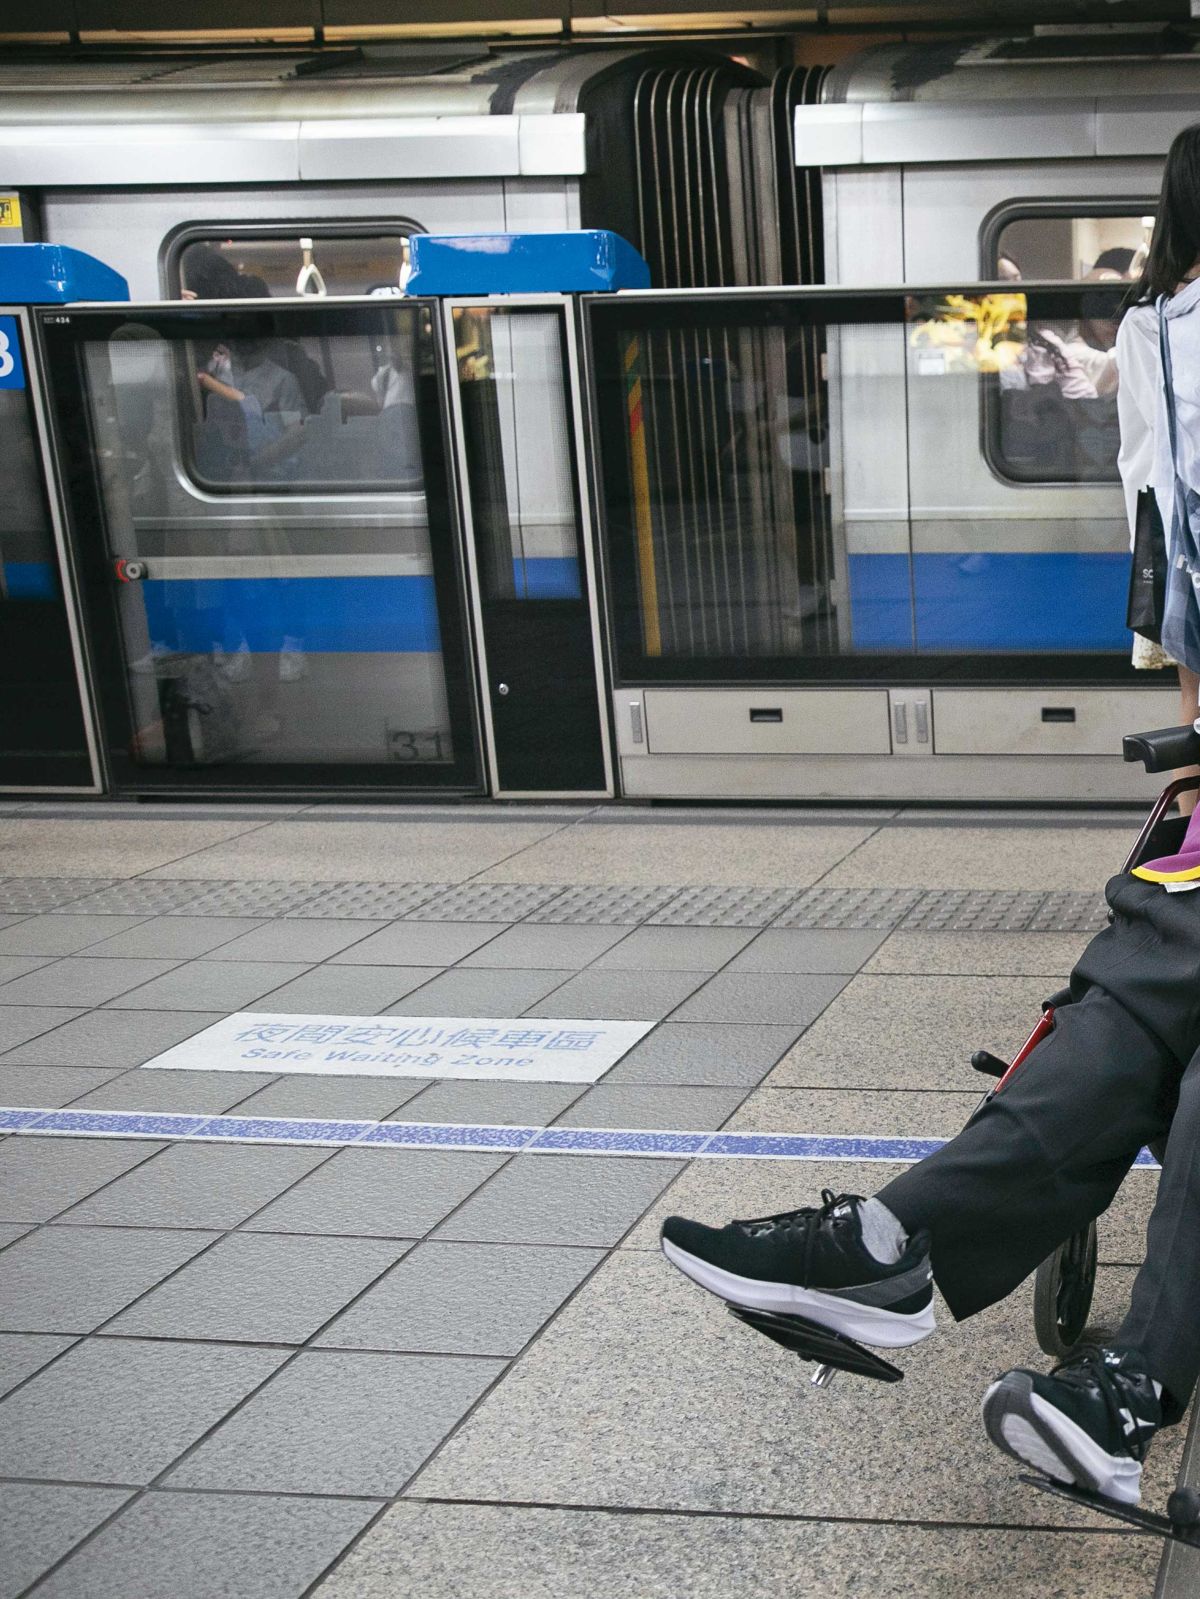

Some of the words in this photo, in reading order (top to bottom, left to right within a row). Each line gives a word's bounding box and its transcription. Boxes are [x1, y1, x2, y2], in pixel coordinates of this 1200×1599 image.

[234, 1023, 607, 1050] 夜間安心候車區
[240, 1048, 312, 1061] Safe
[324, 1050, 443, 1066] Waiting
[450, 1053, 534, 1067] Zone
